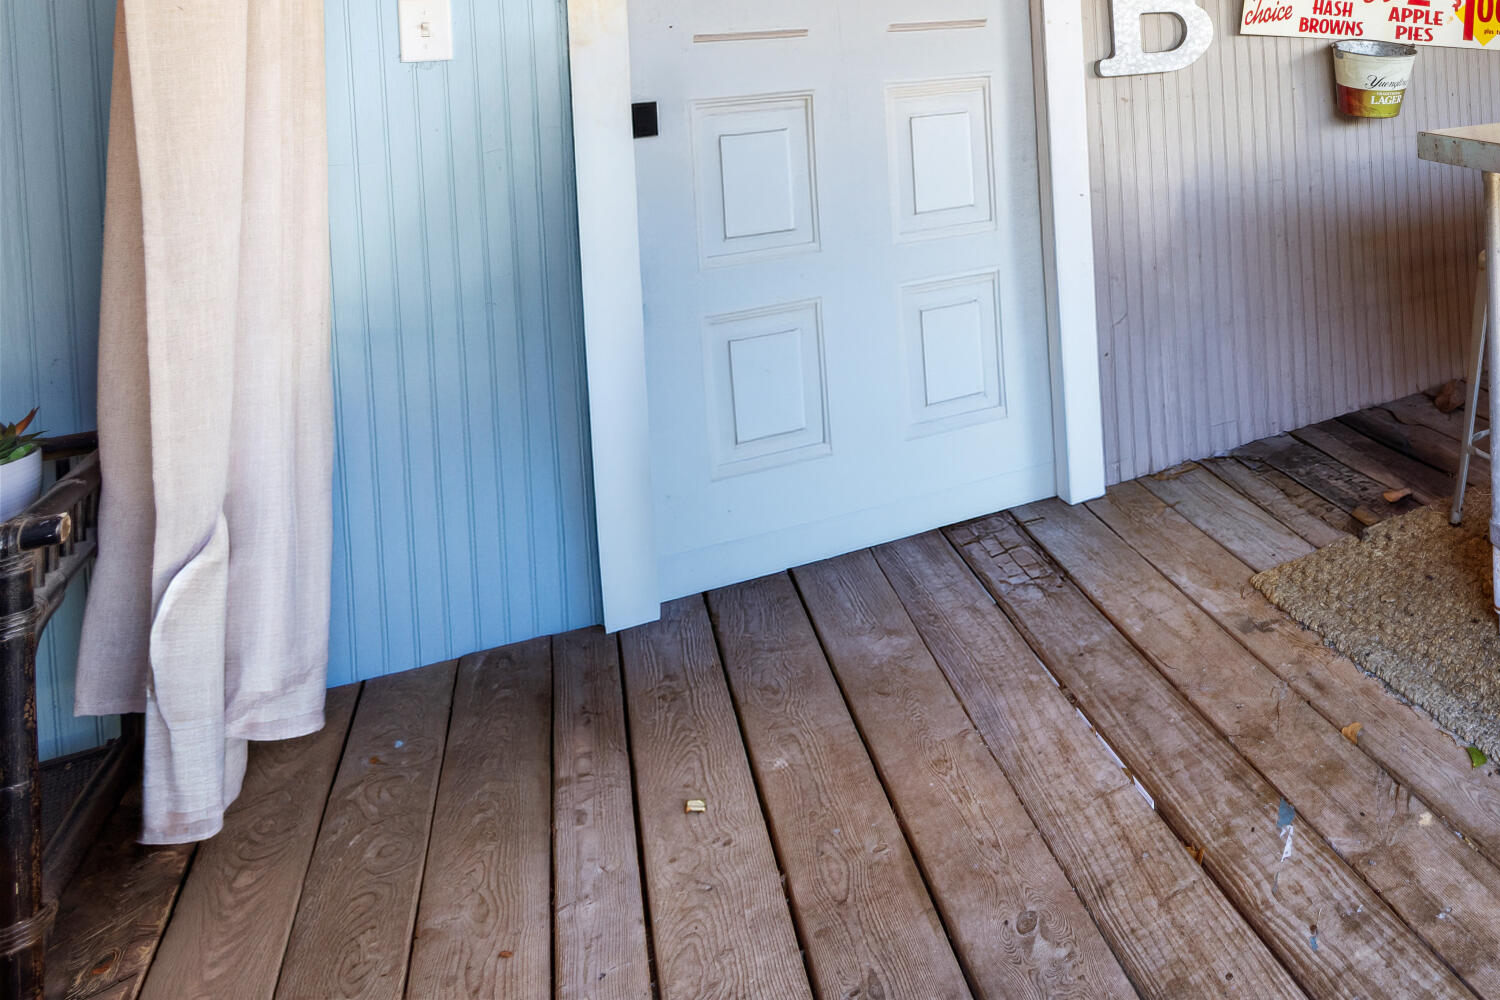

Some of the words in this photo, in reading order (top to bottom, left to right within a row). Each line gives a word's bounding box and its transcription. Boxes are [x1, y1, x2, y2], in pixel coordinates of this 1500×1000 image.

[1312, 0, 1354, 18] HASH
[1388, 6, 1444, 26] APPLE
[1299, 18, 1364, 37] BROWNS
[1395, 25, 1434, 43] PIES
